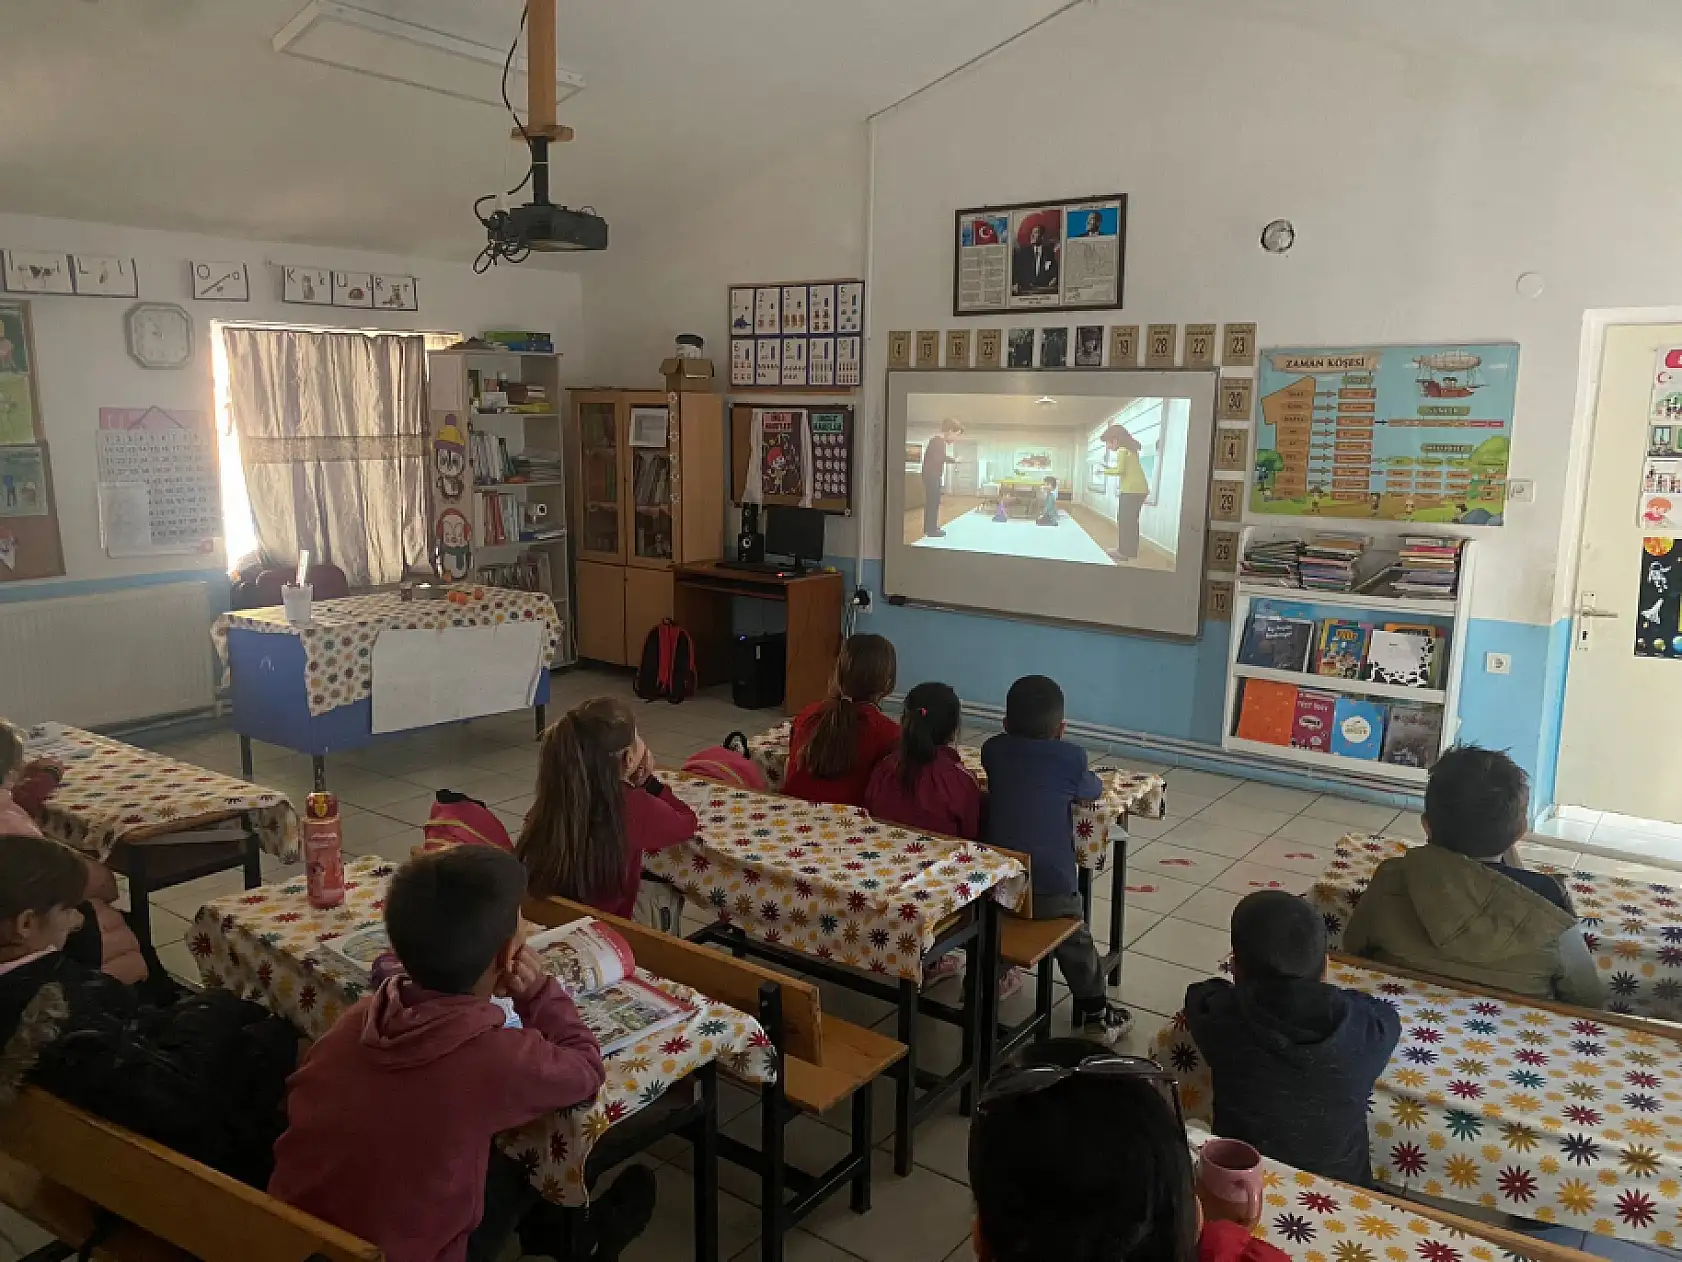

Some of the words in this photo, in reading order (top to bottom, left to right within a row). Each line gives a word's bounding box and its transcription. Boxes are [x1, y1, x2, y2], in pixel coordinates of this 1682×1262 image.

[287, 267, 296, 284] K
[336, 273, 349, 288] U
[1285, 359, 1324, 369] ZAMAN
